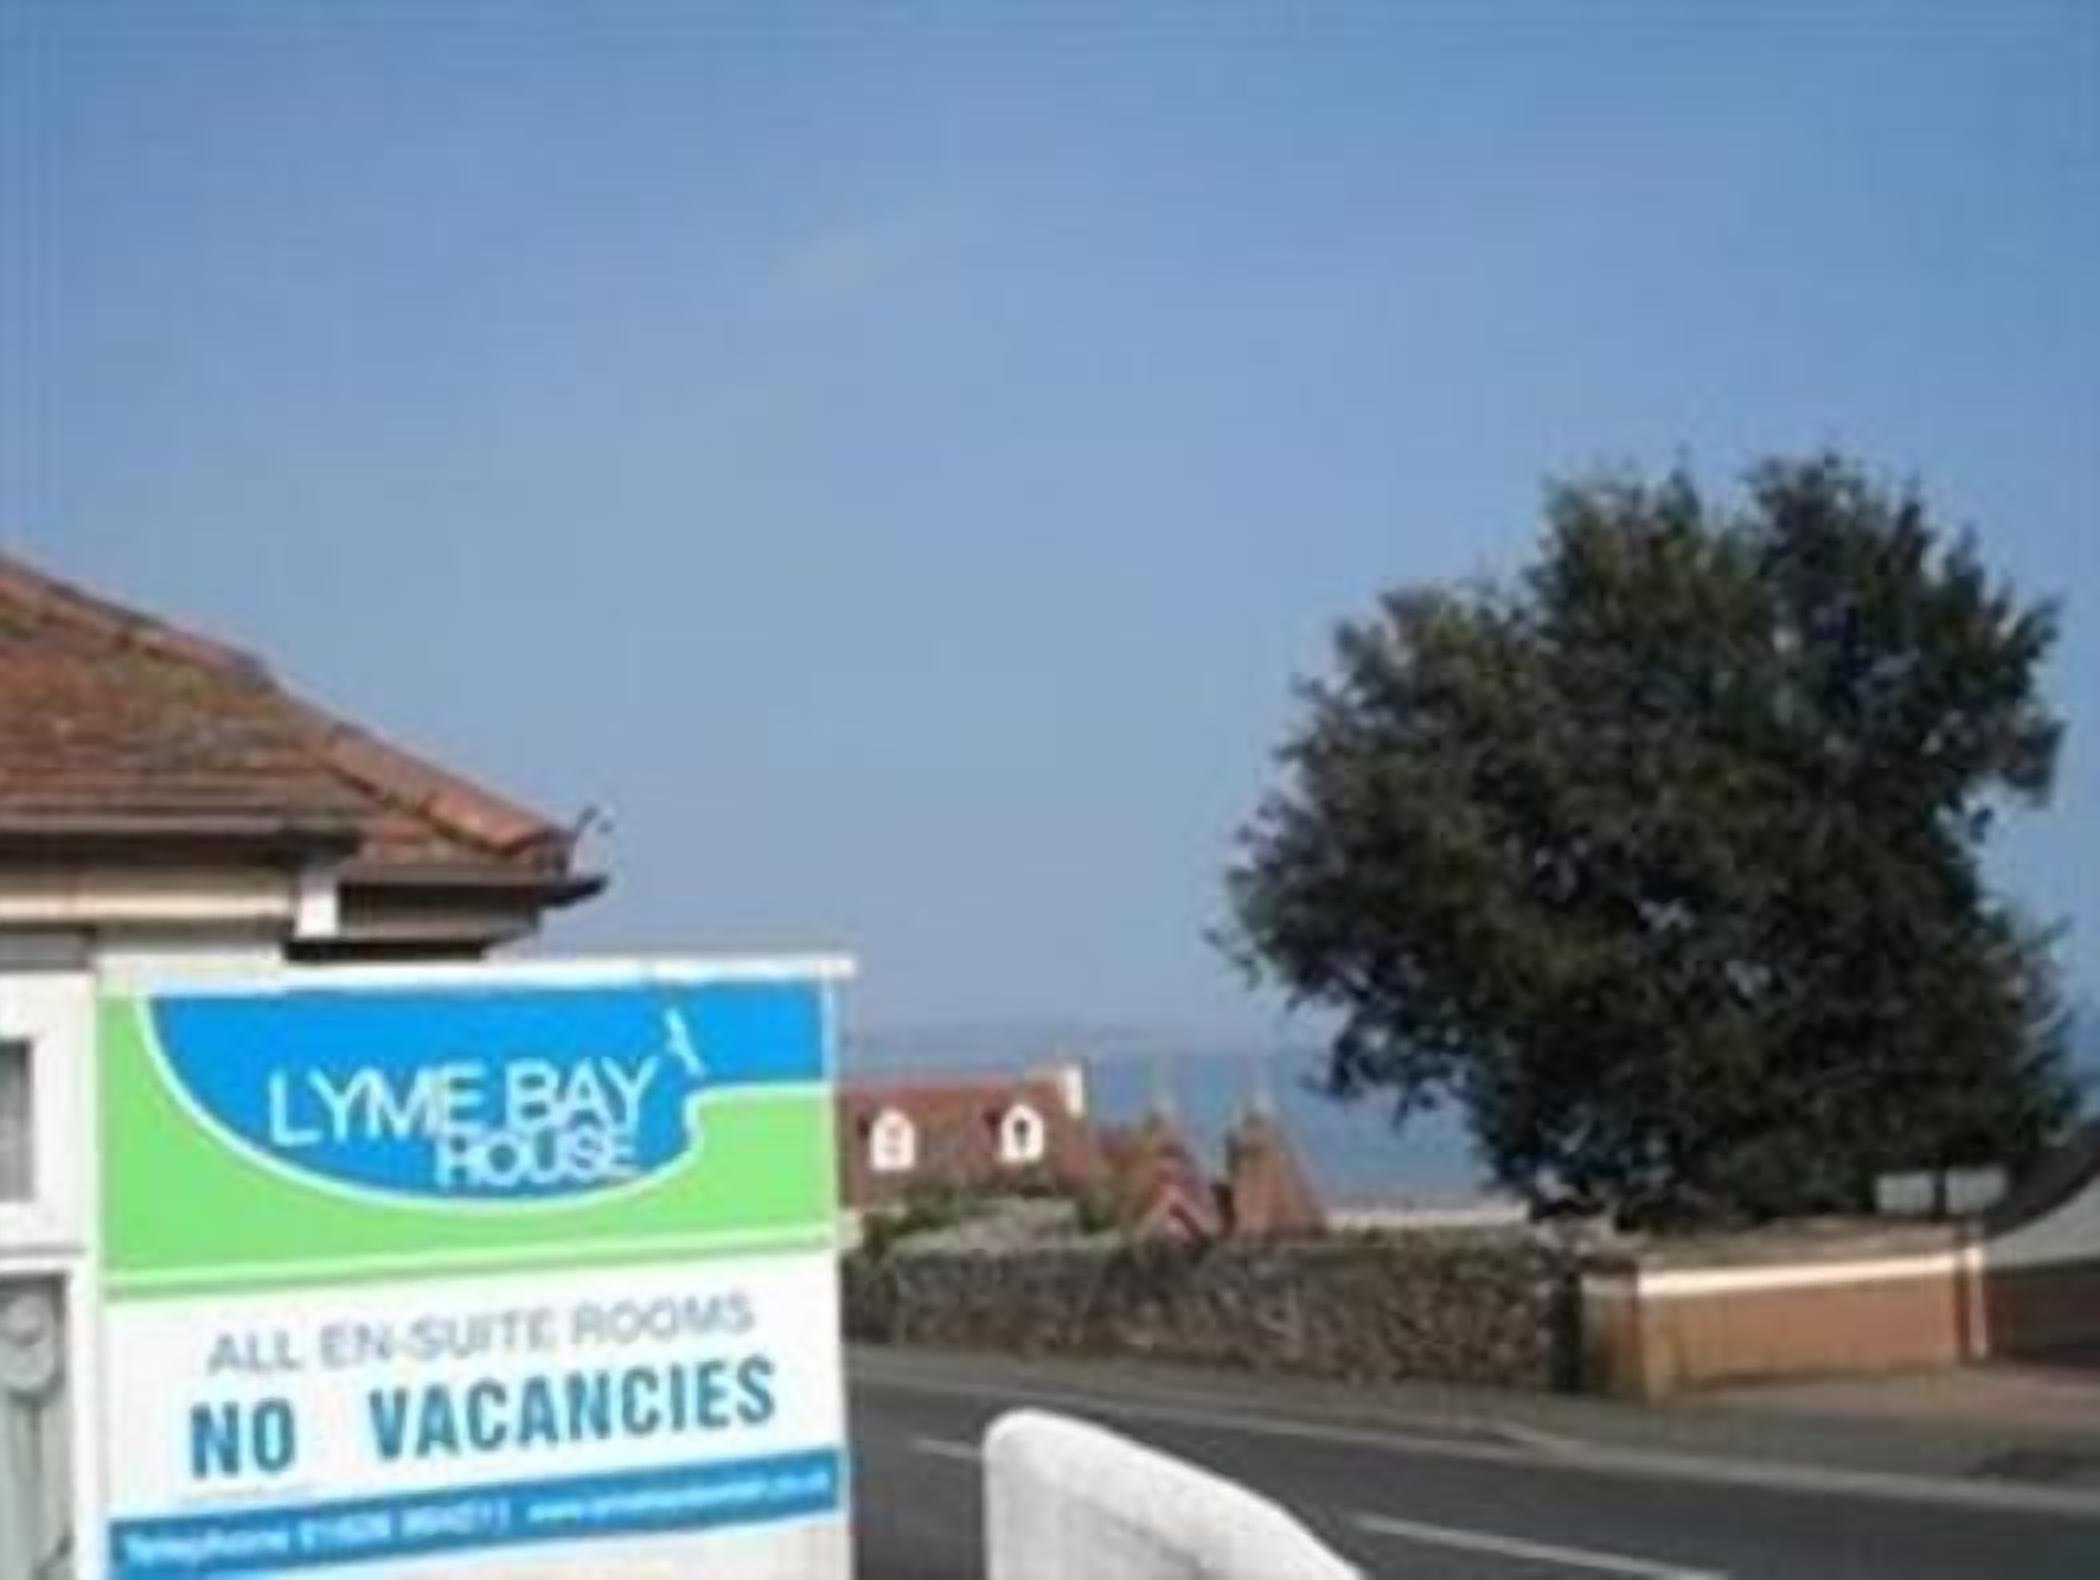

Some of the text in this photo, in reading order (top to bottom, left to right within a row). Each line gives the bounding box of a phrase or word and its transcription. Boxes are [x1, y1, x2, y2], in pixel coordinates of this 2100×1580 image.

[267, 1054, 660, 1149] LYME BAY
[434, 1131, 638, 1190] HOUSE
[207, 1289, 756, 1376] ALL EN-SUITE ROOMS
[189, 1355, 776, 1479] NO VACANCIES
